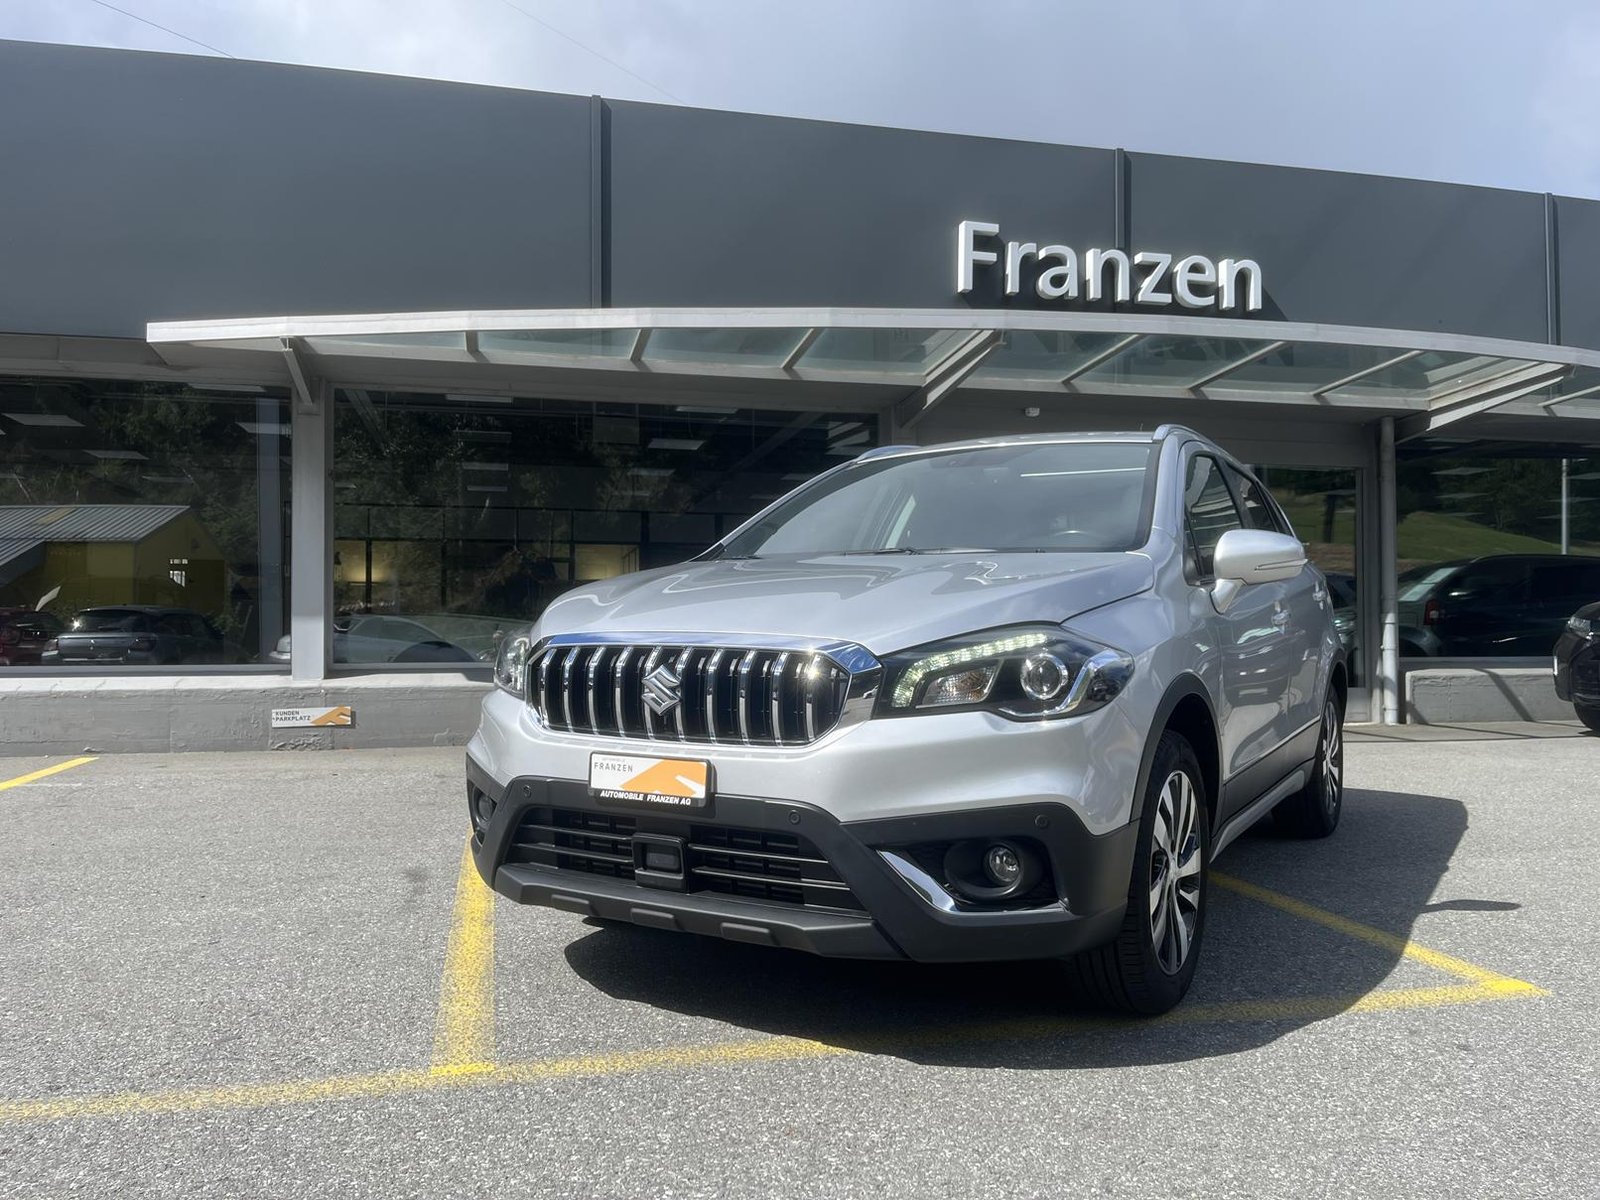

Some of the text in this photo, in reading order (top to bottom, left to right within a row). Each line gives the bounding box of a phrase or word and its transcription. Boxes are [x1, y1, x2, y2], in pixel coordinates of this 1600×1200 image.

[957, 220, 1263, 311] Franzen
[593, 762, 633, 772] FRANZEN
[600, 790, 692, 806] AUTOMOBILE FRANZEN AG
